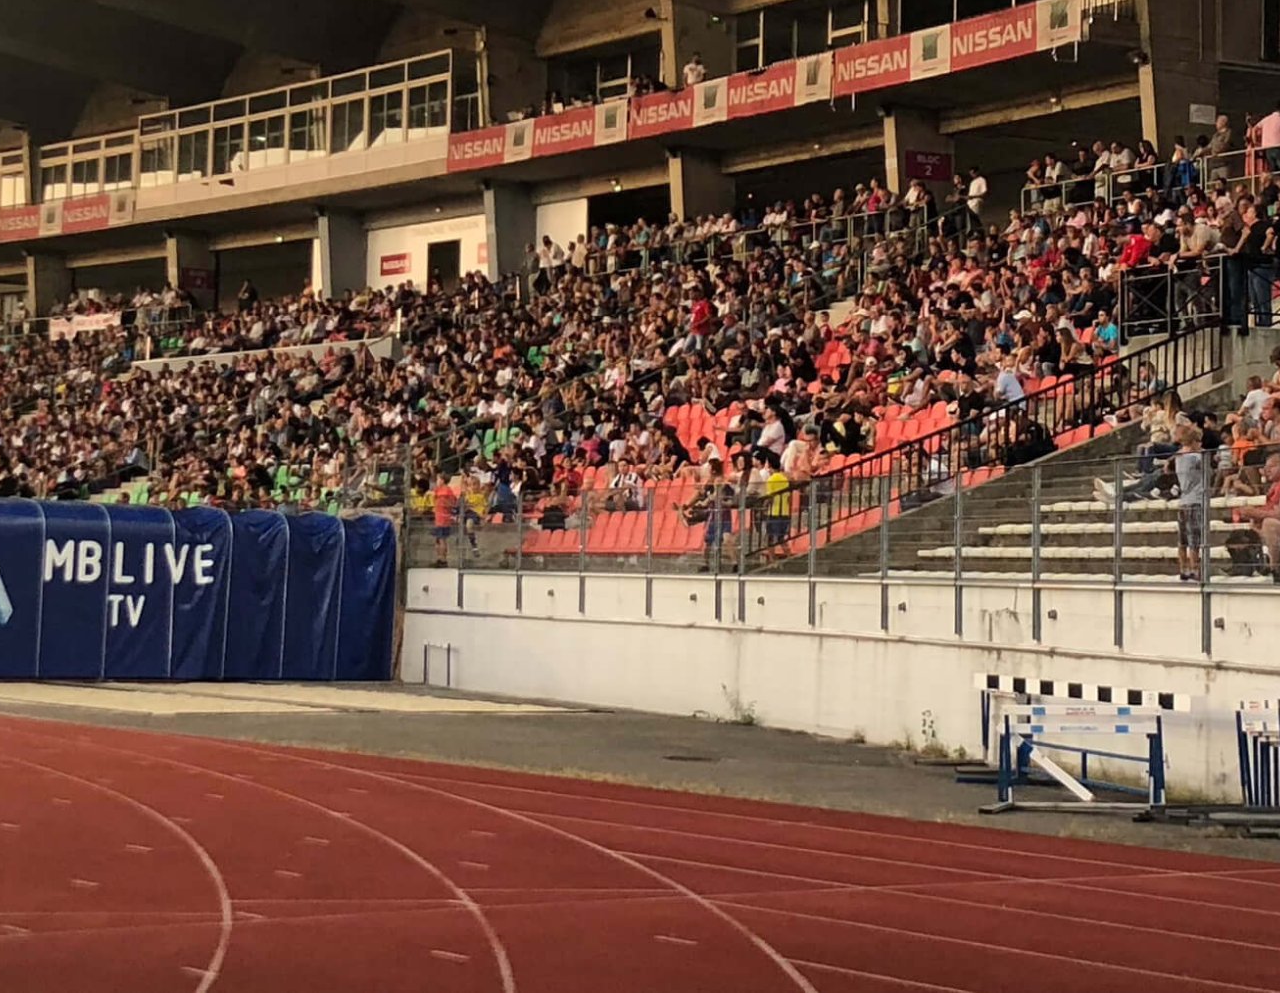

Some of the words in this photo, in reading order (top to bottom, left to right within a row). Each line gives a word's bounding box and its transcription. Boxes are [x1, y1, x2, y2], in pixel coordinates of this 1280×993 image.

[952, 17, 1033, 58] NISSAN
[837, 49, 908, 82] NISSAN
[729, 76, 794, 105] NISSAN
[630, 98, 692, 126] NISSAN
[535, 119, 593, 145] NISSAN
[450, 136, 504, 160] NISSAN
[916, 154, 941, 165] BLOC
[924, 165, 933, 176] 2
[64, 205, 108, 223] NISSAN
[113, 541, 214, 585] LIVE
[107, 594, 145, 627] TV
